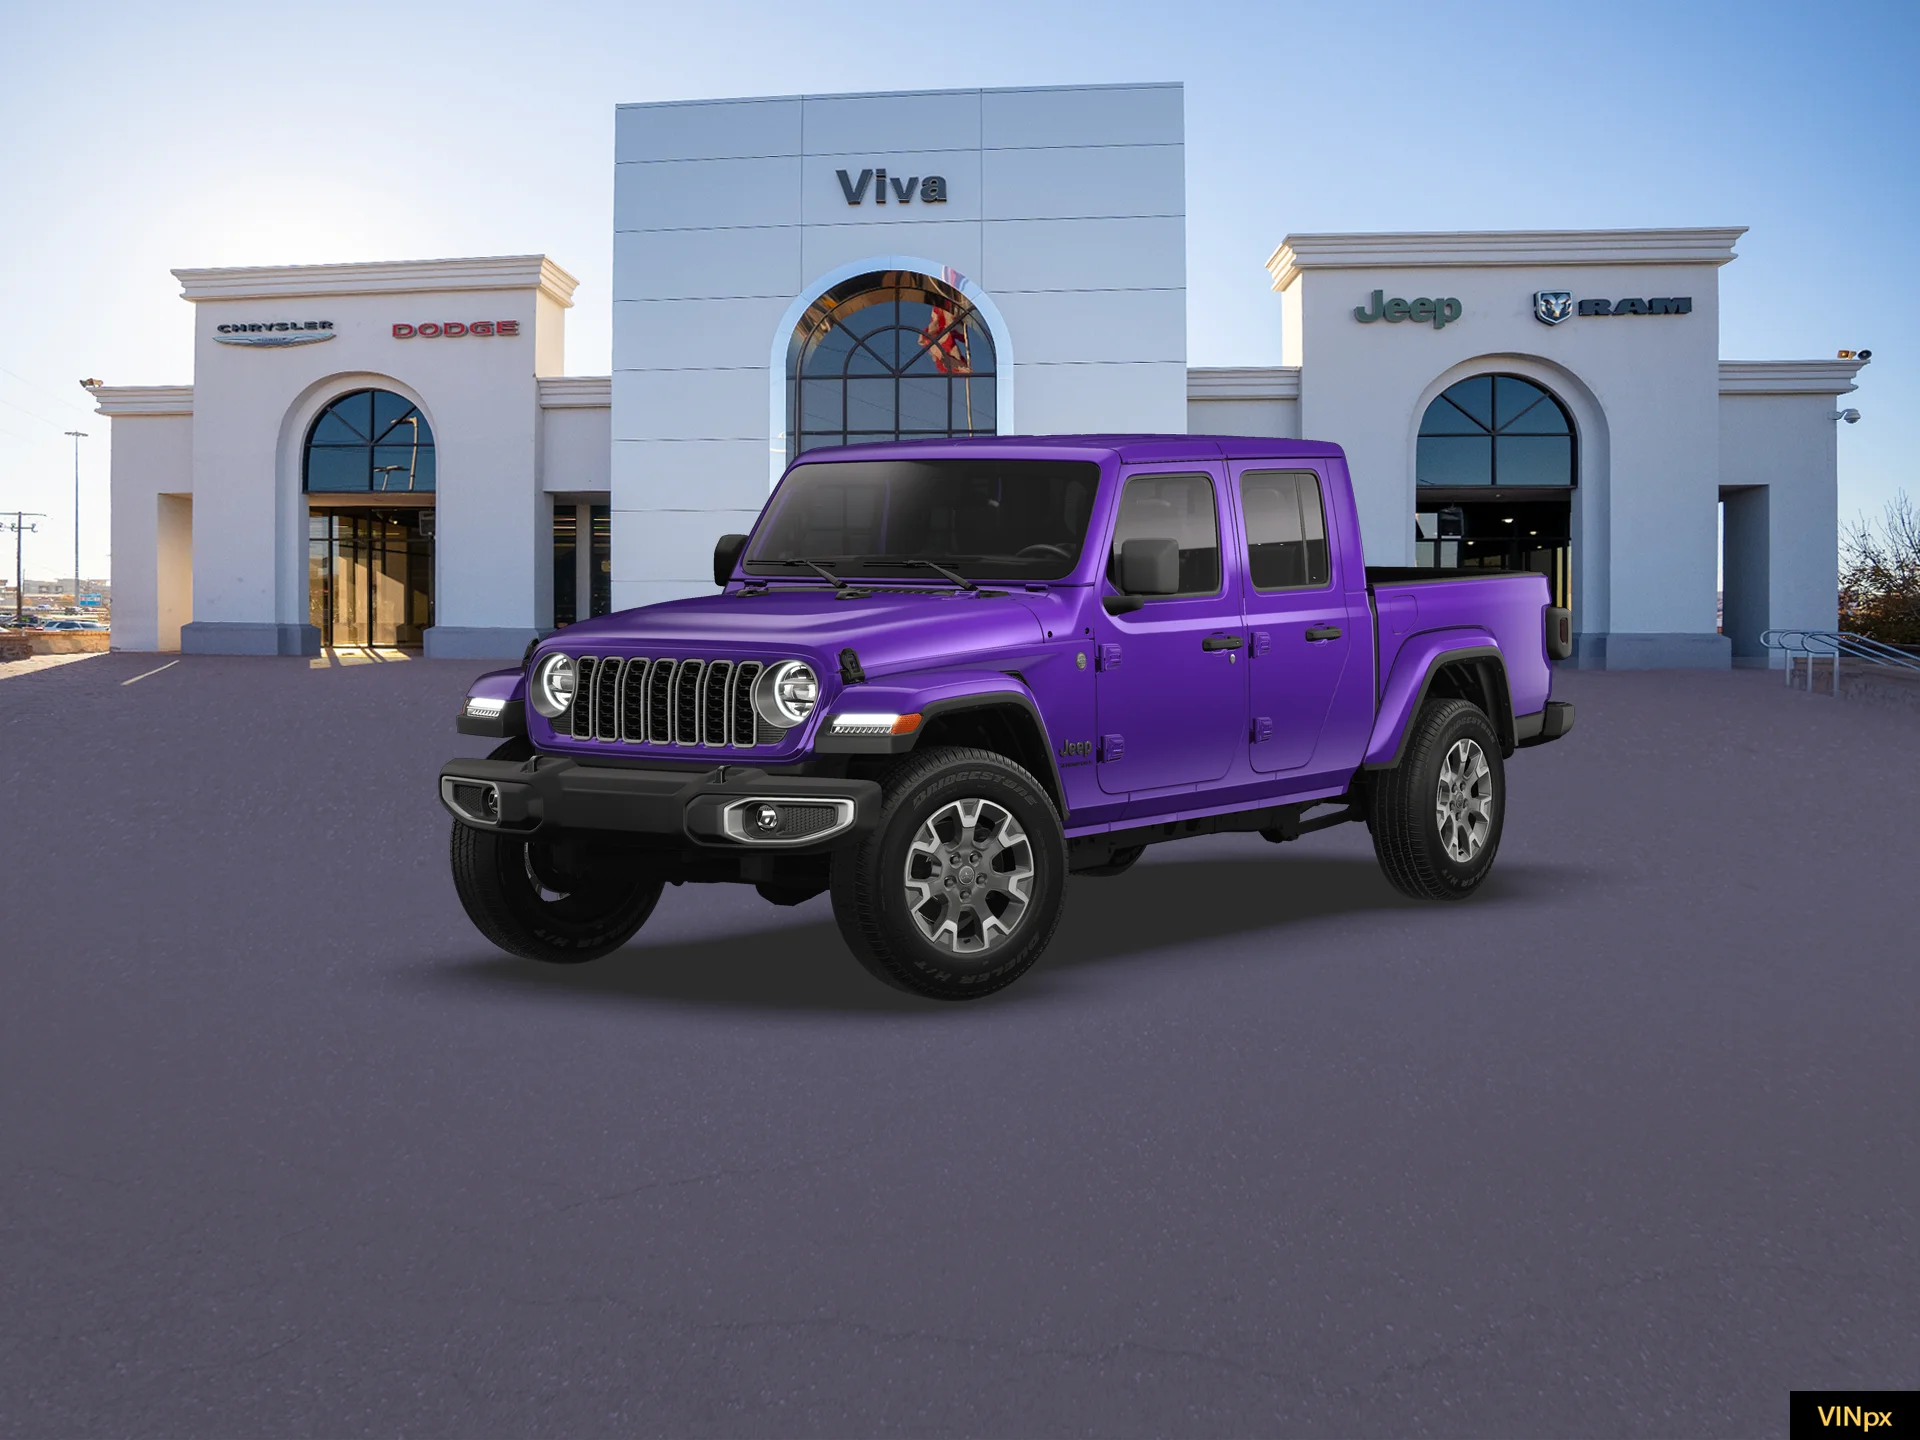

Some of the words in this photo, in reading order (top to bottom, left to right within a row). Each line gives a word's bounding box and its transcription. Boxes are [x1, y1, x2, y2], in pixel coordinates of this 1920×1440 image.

[835, 168, 947, 205] Viva
[1354, 289, 1462, 329] Jeep
[1578, 297, 1692, 317] RAM
[217, 320, 334, 334] CHRYSLER
[391, 320, 520, 339] DODGE
[1059, 739, 1092, 758] Jeep
